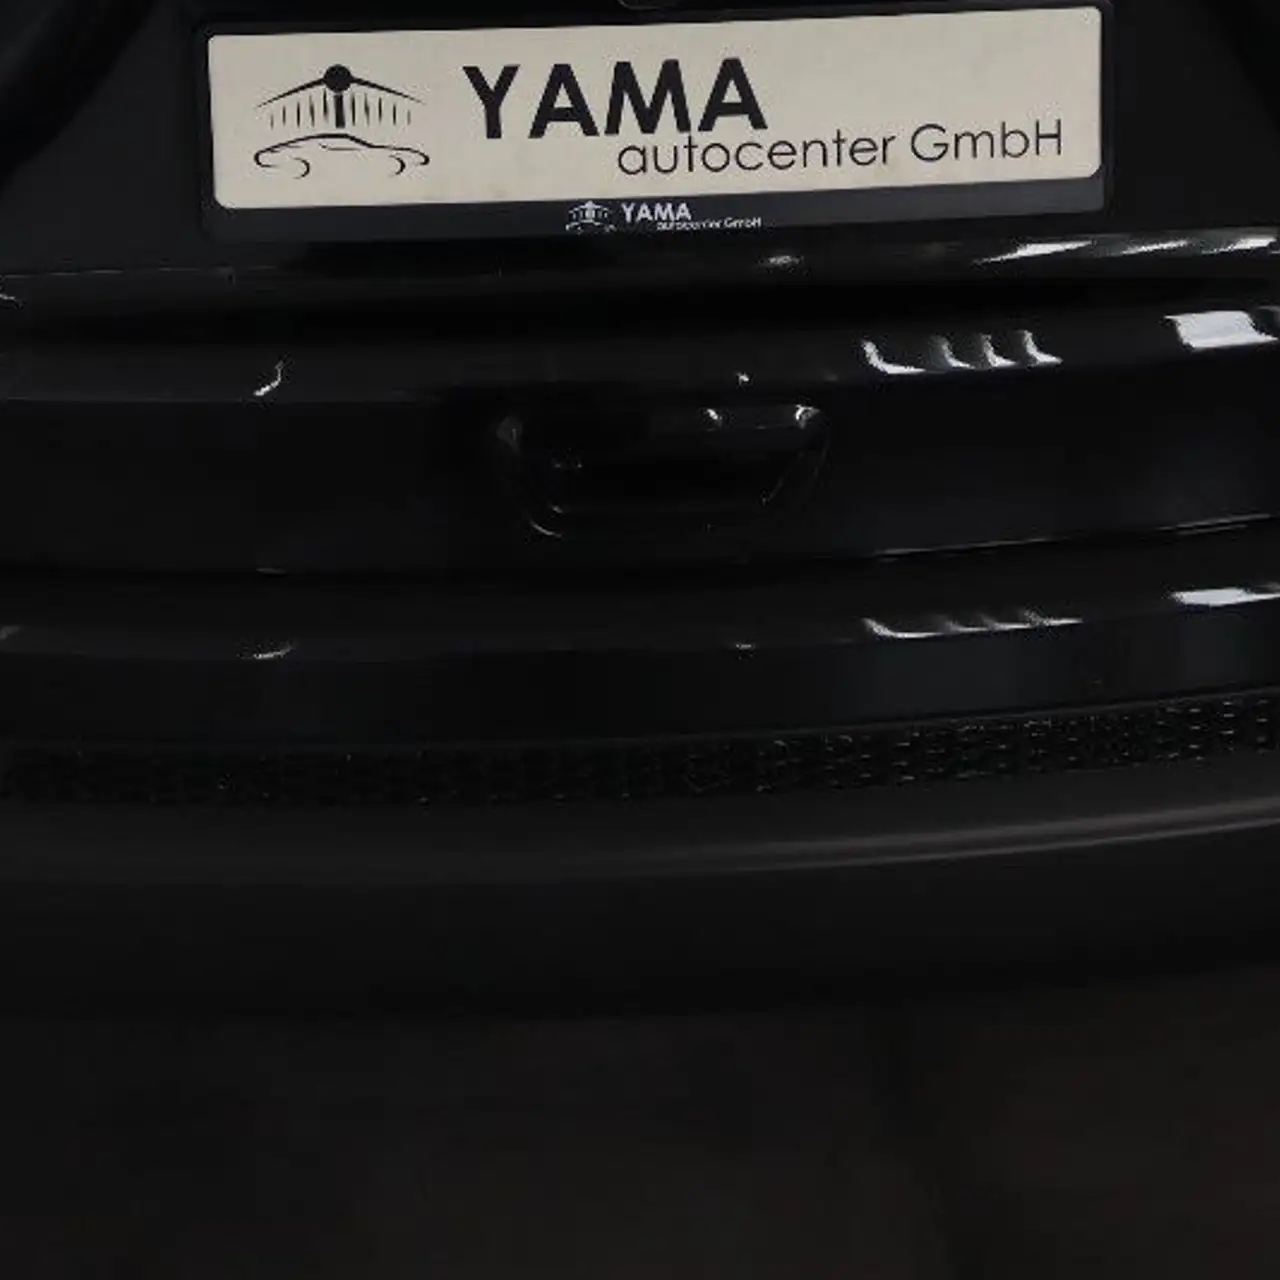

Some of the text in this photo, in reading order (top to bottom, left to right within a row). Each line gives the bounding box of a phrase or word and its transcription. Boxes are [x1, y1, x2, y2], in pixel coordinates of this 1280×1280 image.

[463, 57, 768, 140] YAMA
[617, 118, 1063, 176] autocenter GmbH
[621, 202, 692, 223] YAMA
